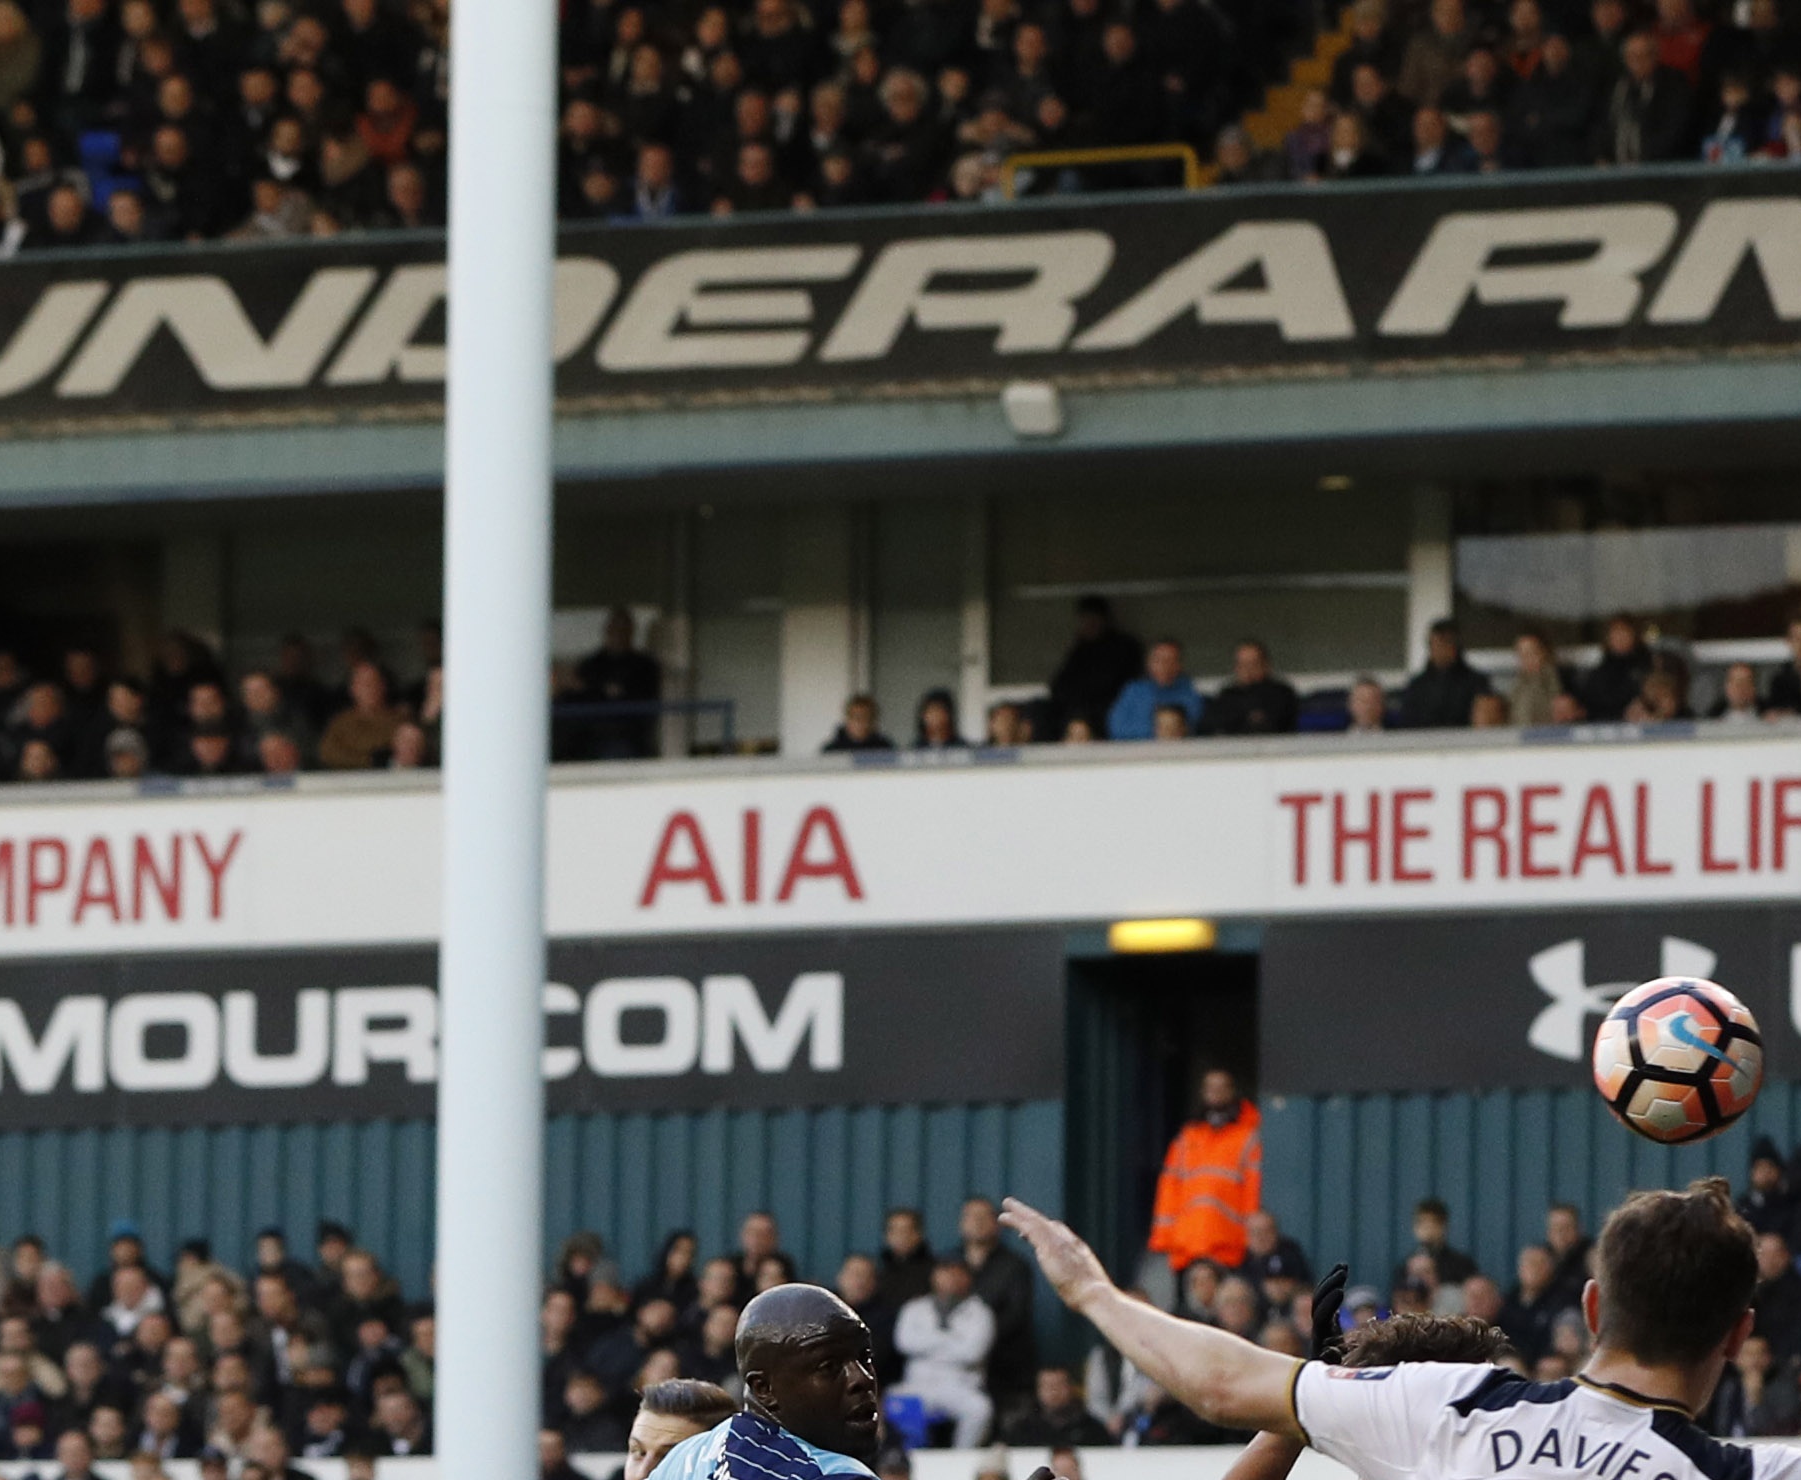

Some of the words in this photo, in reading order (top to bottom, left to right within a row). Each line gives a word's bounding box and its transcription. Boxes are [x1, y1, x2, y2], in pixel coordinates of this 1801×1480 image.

[638, 804, 865, 908] AIA
[1277, 788, 1435, 886] THE
[1460, 781, 1674, 882] REAL
